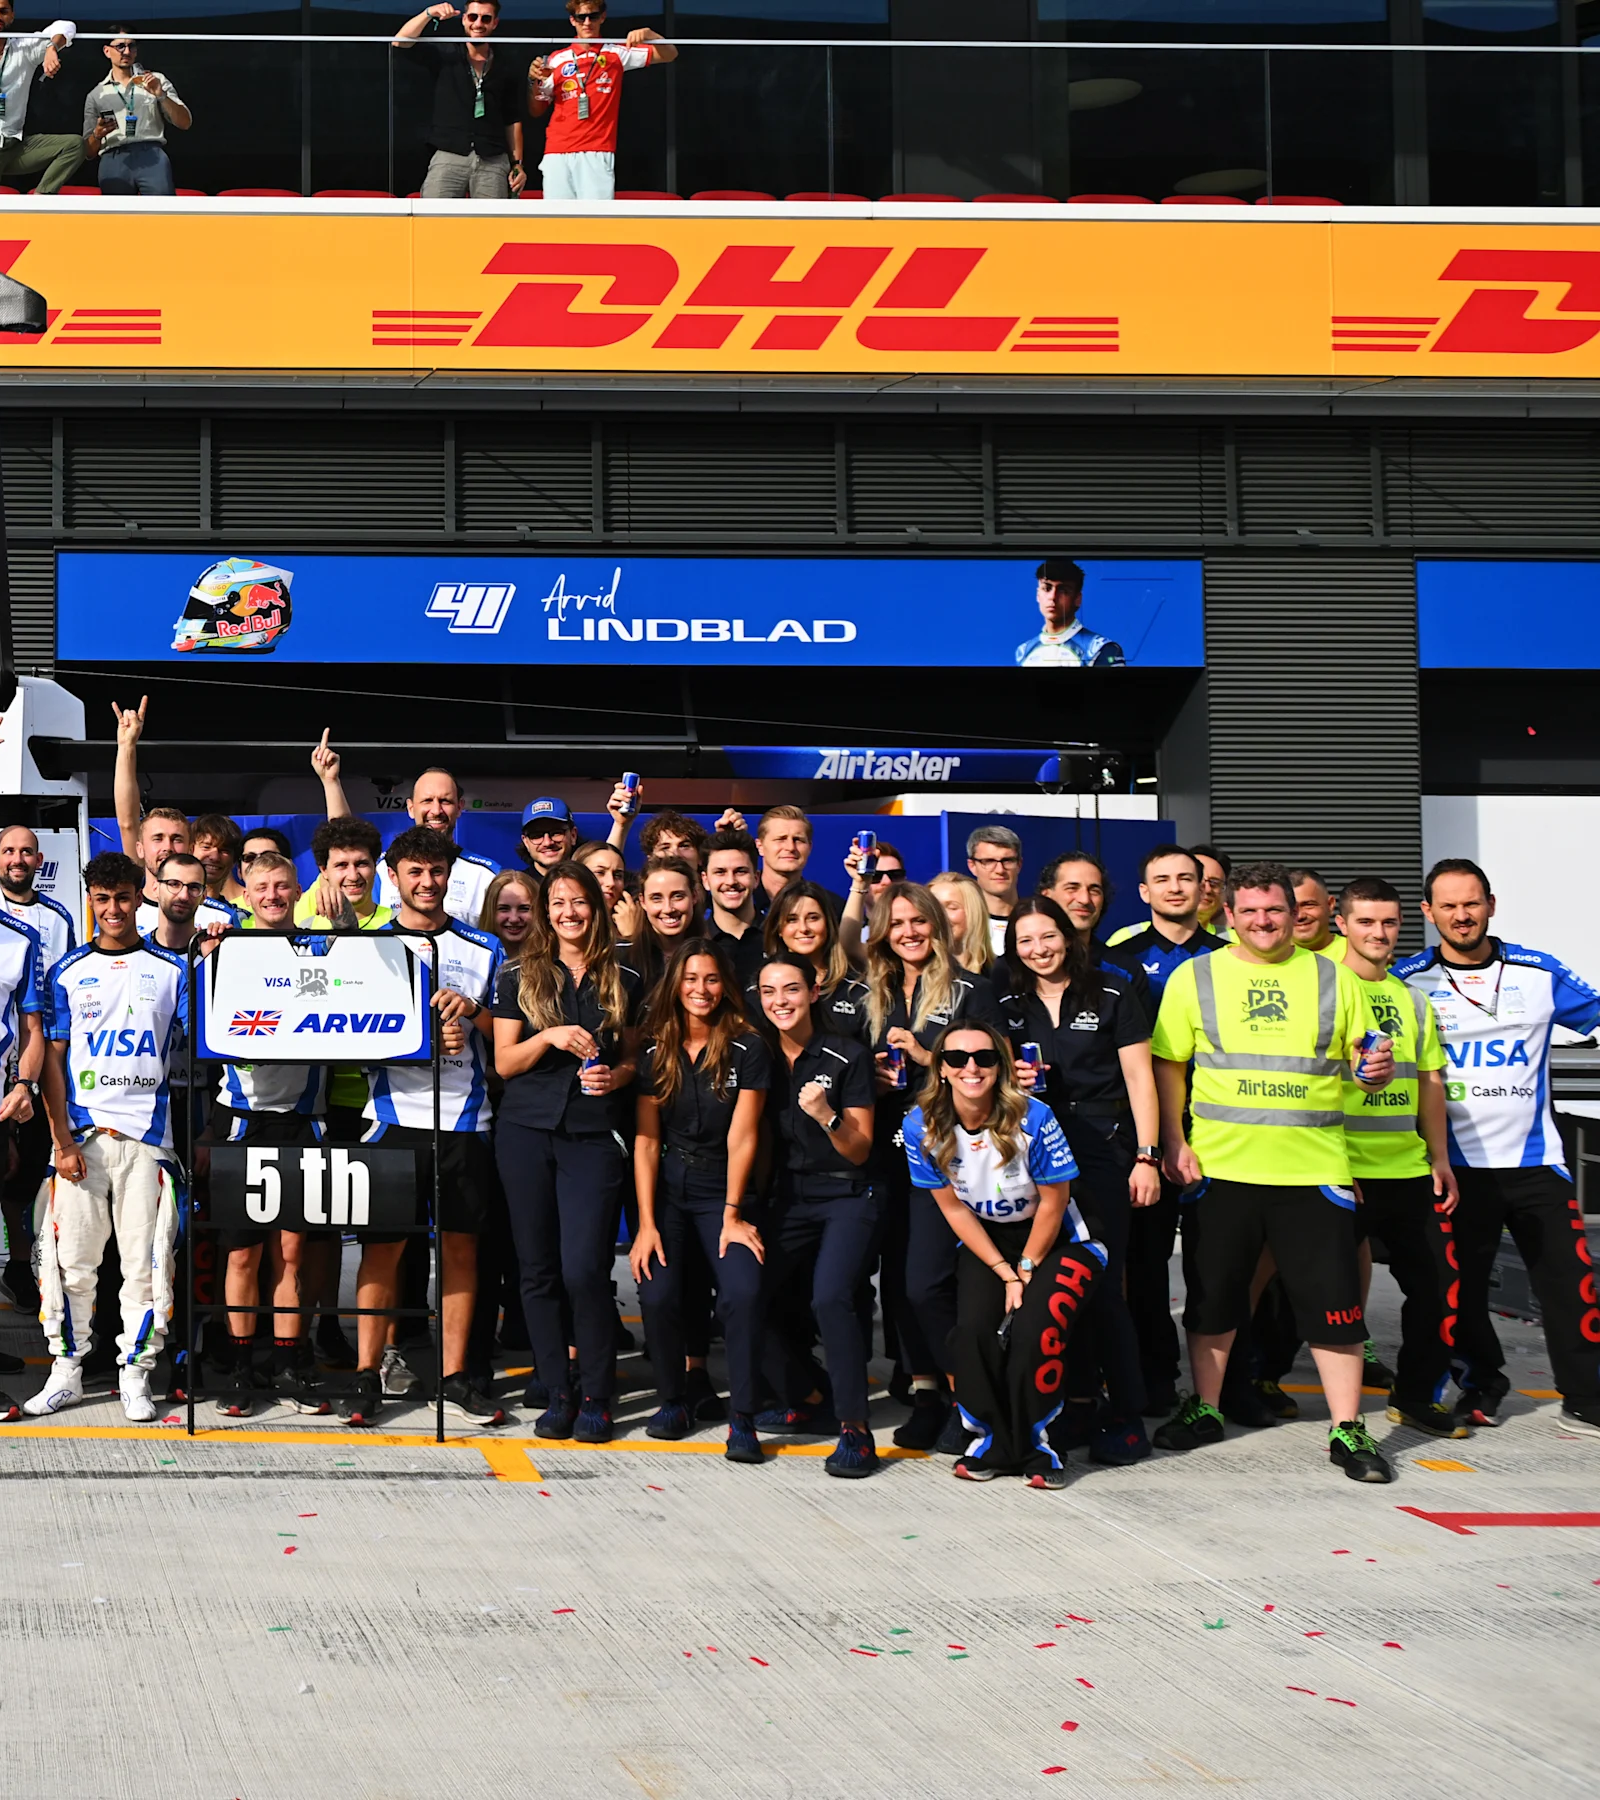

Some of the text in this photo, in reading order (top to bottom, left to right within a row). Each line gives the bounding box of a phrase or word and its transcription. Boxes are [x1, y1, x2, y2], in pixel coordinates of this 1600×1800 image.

[472, 243, 1019, 351] DHL
[541, 567, 621, 621] Arvid
[425, 583, 516, 634] 41
[216, 608, 281, 638] Red Bull
[548, 618, 857, 643] LINDBLAD
[813, 749, 961, 782] Airtasker
[468, 855, 492, 866] HUGO
[47, 901, 67, 915] HUGO
[3, 916, 28, 931] HUGO
[460, 929, 488, 943] HUGO
[59, 951, 83, 969] HUGO
[151, 948, 177, 961] HUGO
[1508, 954, 1542, 963] HUGO
[1399, 960, 1426, 975] HUGO
[263, 977, 291, 987] VISA
[1250, 979, 1280, 988] VISA
[79, 1001, 101, 1009] TUDOR
[1369, 995, 1394, 1003] VISA
[81, 1010, 102, 1019] Mobil
[832, 1005, 856, 1015] Red Bull
[293, 1013, 406, 1033] ARVID
[1075, 1016, 1087, 1024] Red
[84, 1029, 157, 1057] VISA
[1441, 1039, 1529, 1068] VISA
[100, 1075, 156, 1088] Cash App
[1237, 1079, 1308, 1100] Airtasker
[1472, 1086, 1535, 1099] Cash App
[1362, 1090, 1411, 1106] Airtask
[245, 1147, 370, 1225] 5 th
[1325, 1305, 1363, 1325] HUG
[1034, 1256, 1092, 1394] HUGO
